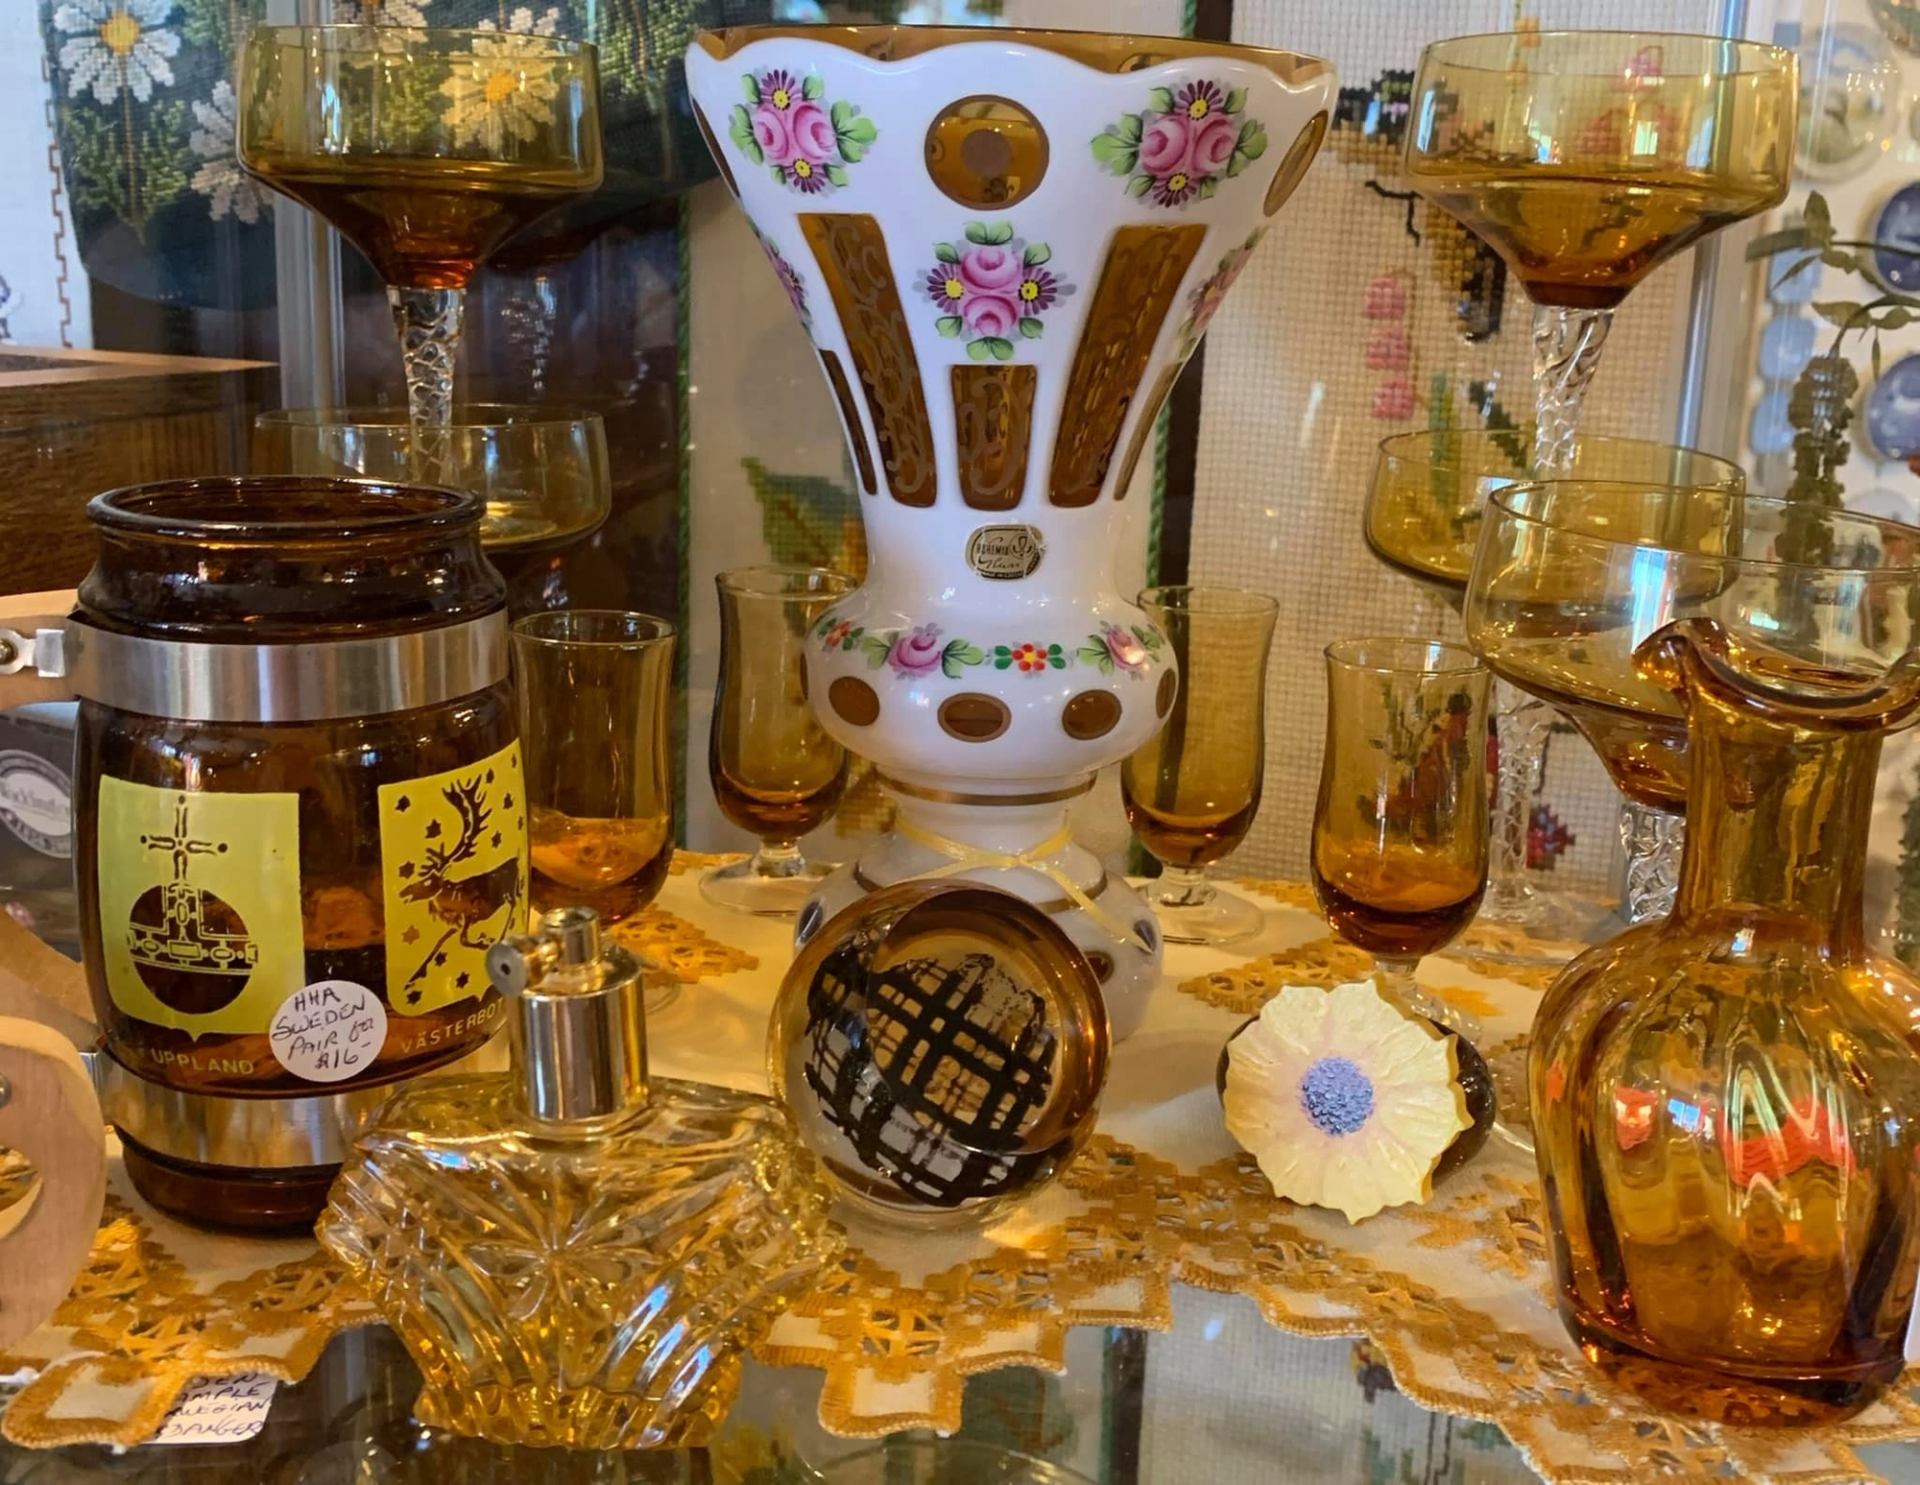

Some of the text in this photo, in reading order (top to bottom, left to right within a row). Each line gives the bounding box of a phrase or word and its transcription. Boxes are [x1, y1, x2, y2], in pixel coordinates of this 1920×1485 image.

[294, 986, 341, 1012] HHA
[271, 993, 365, 1041] SWEDEN
[287, 1030, 338, 1061] PAIR
[150, 1047, 255, 1076] UPPLAND
